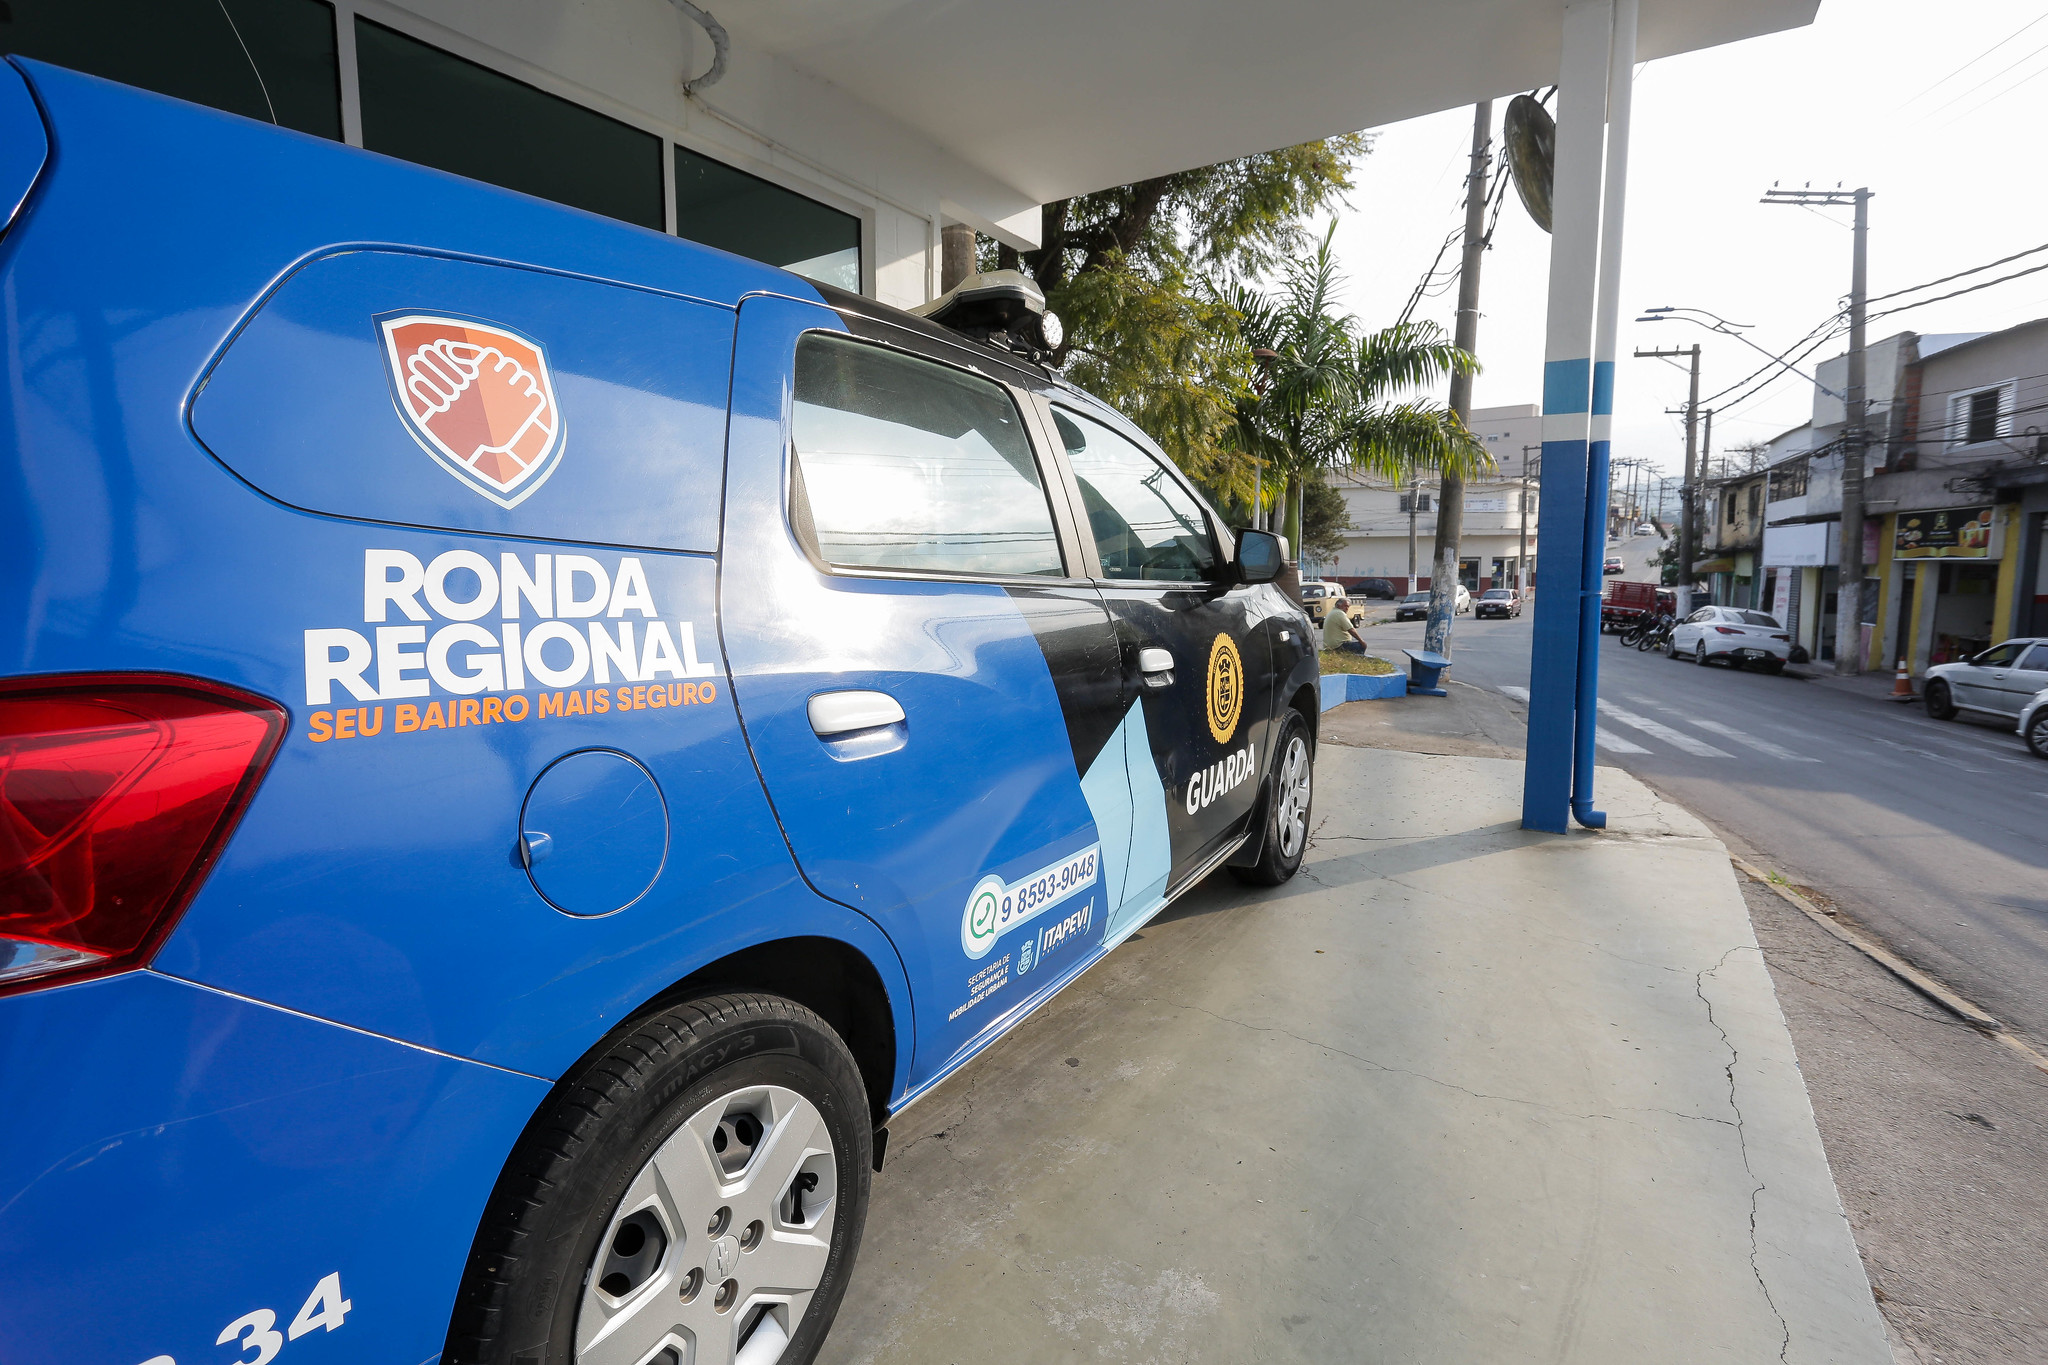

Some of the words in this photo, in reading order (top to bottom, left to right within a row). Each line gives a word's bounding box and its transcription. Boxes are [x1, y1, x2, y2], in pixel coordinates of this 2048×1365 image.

[364, 549, 658, 622] RONDA
[304, 621, 715, 706] REGIONAL
[307, 705, 384, 743] SEU
[394, 696, 530, 734] BAIRRO
[538, 688, 610, 719] MAIS
[616, 681, 717, 711] SEGURO
[1186, 743, 1255, 816] GUARDA
[1001, 896, 1012, 923] 9
[1017, 853, 1094, 914] 8593-9048
[1042, 905, 1089, 951] ITAPEVI
[948, 991, 985, 1022] MOBILIDADE
[985, 976, 1008, 997] URBANA
[967, 959, 1002, 988] SECRETARIA
[1002, 953, 1011, 965] DE
[970, 968, 1004, 997] SEGURANÇA
[1004, 964, 1010, 974] E
